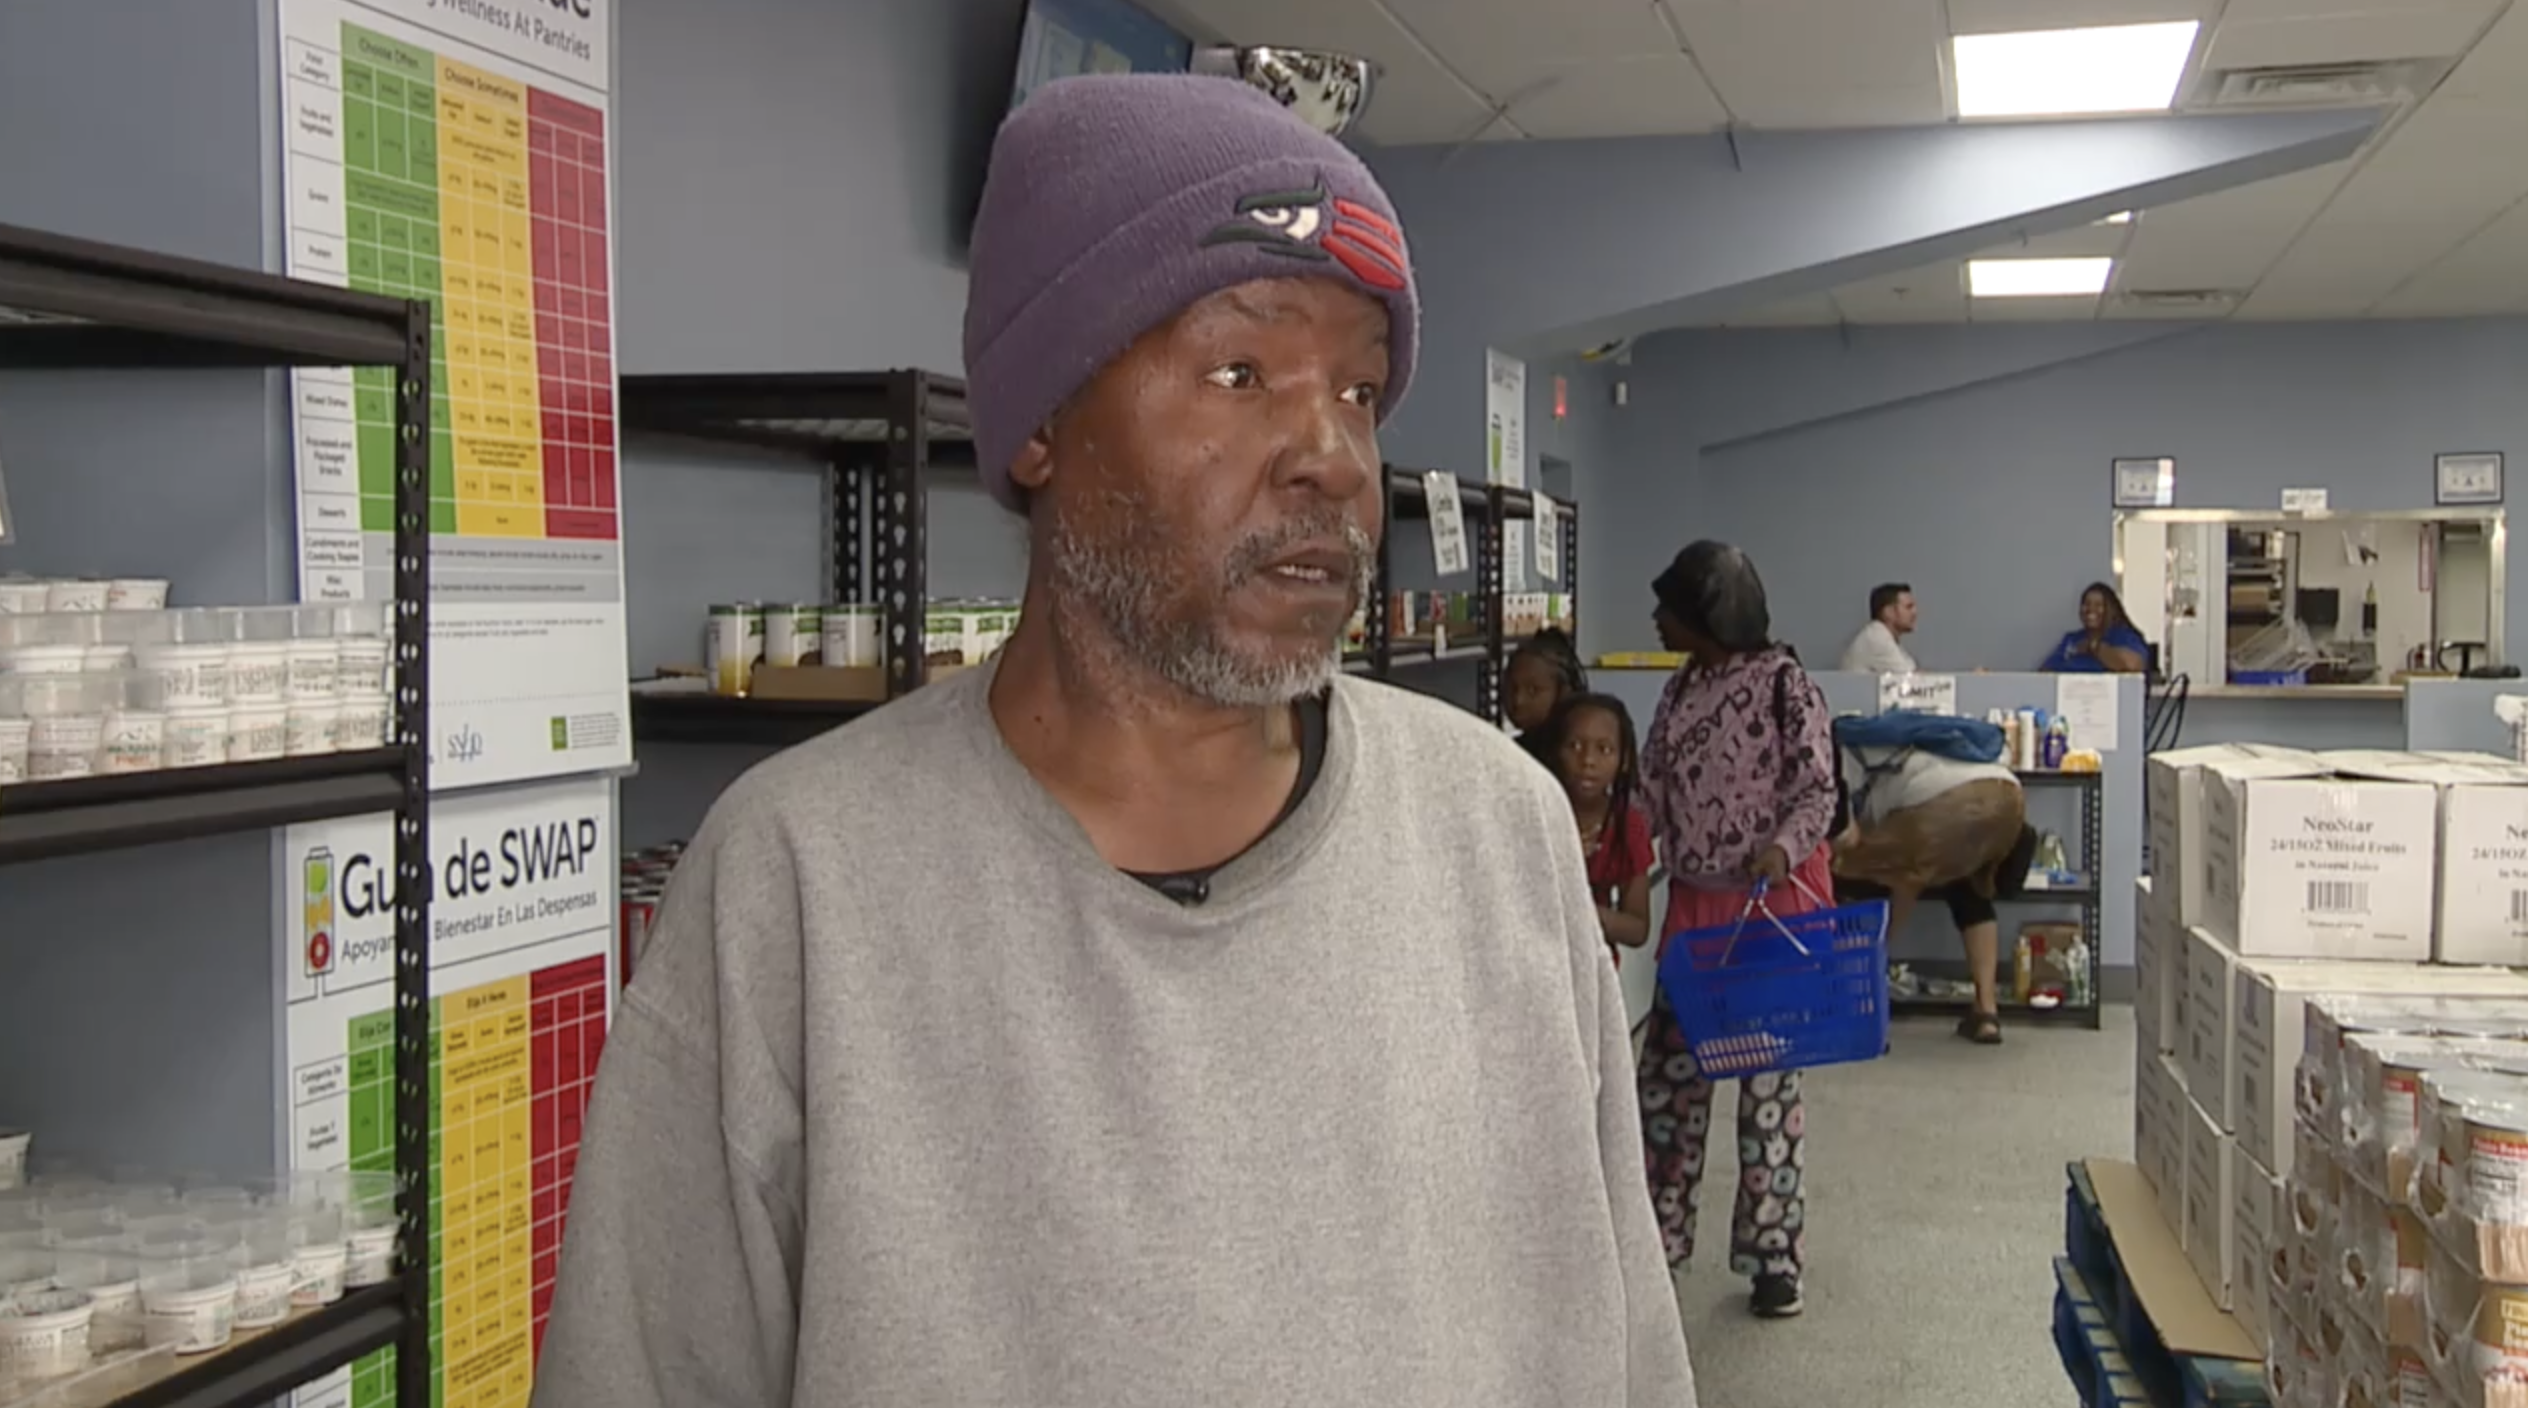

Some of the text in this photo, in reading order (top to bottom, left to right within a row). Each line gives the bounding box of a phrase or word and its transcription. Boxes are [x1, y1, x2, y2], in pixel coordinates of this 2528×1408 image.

[514, 12, 531, 38] At
[533, 18, 591, 60] Pantries
[1898, 683, 1936, 699] LMIT
[2302, 816, 2374, 834] NeoStar
[2327, 839, 2365, 853] Mixed
[2368, 841, 2407, 855] Fruits
[445, 837, 491, 899] de
[499, 817, 597, 888] SWAP
[2295, 860, 2379, 872] in Natural Juice
[435, 912, 494, 942] Bienestar
[497, 906, 512, 928] En
[516, 901, 535, 923] Las
[537, 890, 597, 920] Despensas
